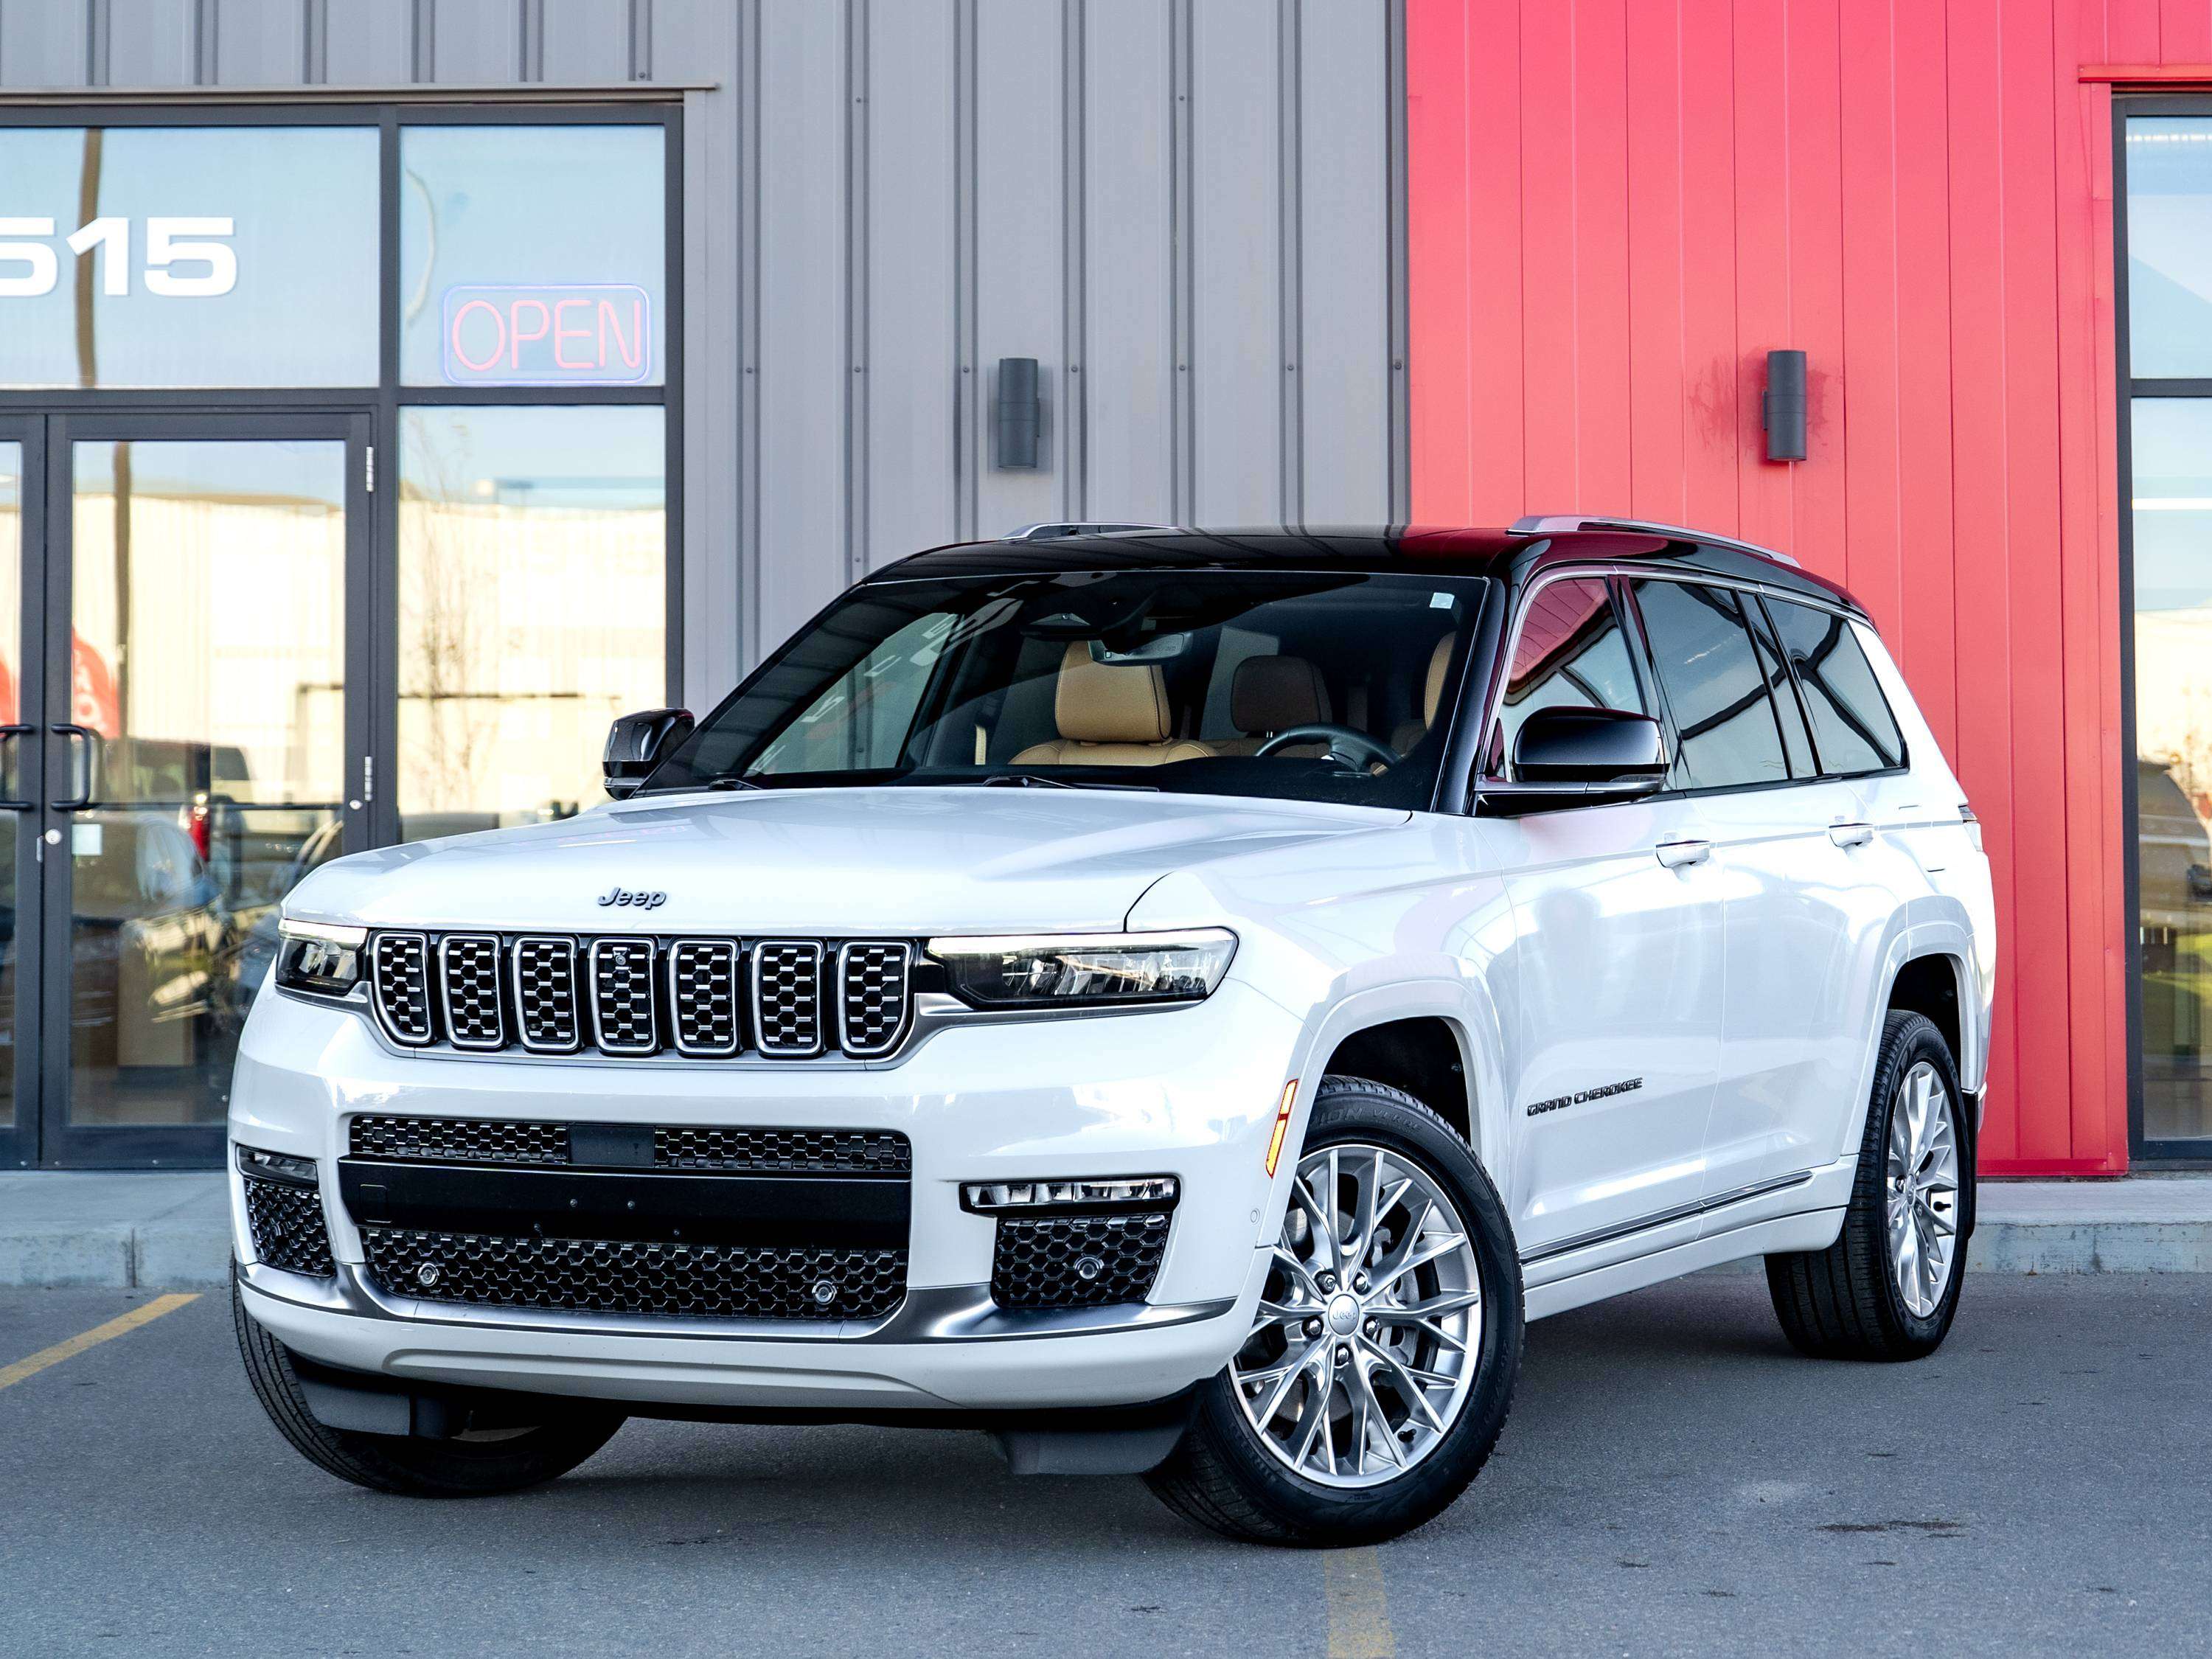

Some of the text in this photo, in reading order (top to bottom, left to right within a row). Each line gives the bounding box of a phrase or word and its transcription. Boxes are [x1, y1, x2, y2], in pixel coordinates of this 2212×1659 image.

[0, 217, 237, 297] 515
[451, 299, 642, 372] OPEN
[597, 886, 667, 911] Jeep
[1527, 1077, 1643, 1116] GRAND CHEROKEE
[1332, 1310, 1357, 1324] Jeep
